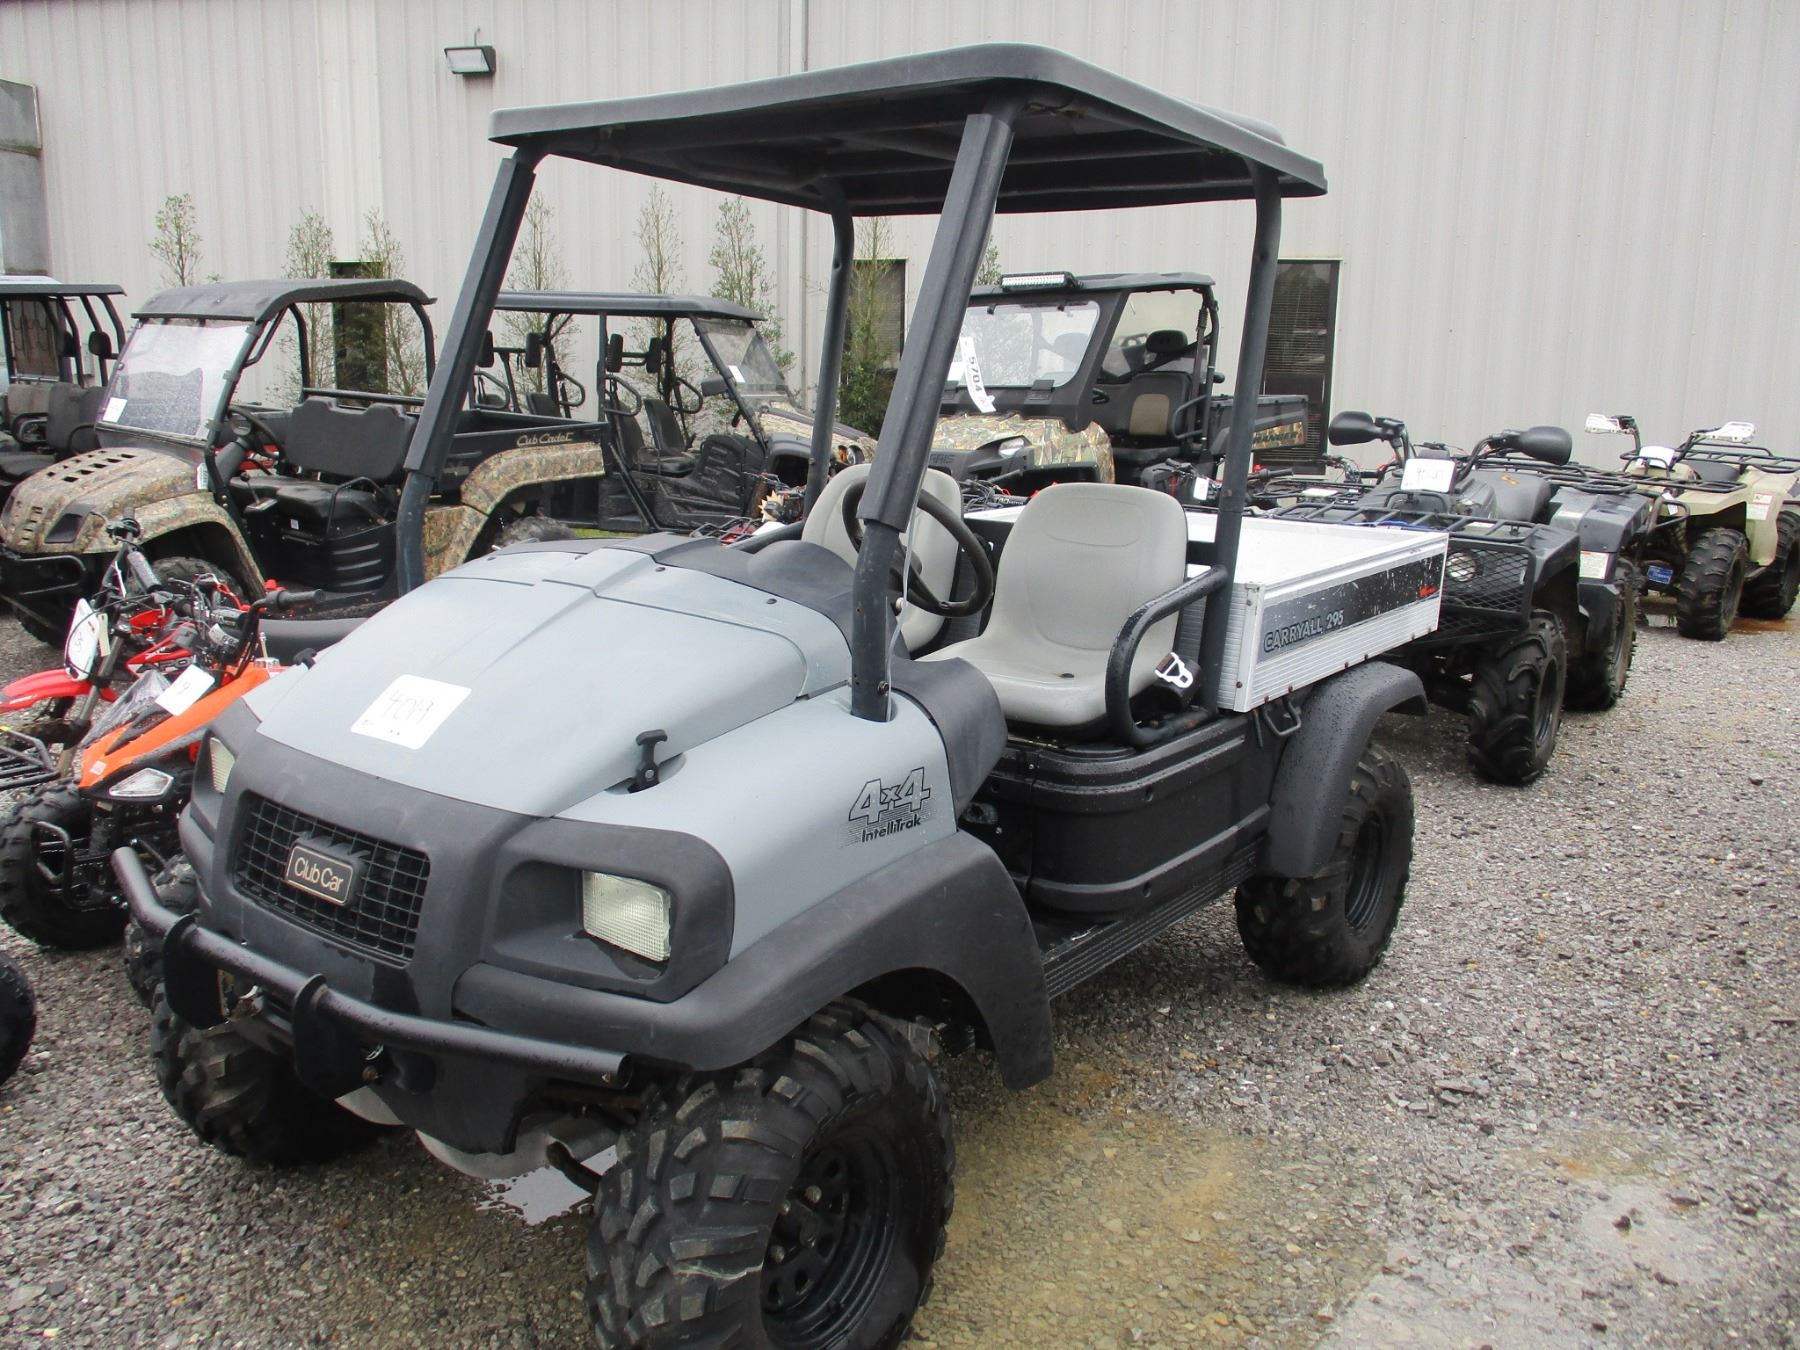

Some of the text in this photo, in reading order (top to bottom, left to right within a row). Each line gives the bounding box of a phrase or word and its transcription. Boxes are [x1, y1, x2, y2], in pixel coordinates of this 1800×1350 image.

[516, 432, 575, 448] Cub Cadet
[1263, 608, 1345, 653] CARRYALL 295
[848, 767, 931, 826] 4x4
[861, 814, 922, 843] IntelliTrak
[294, 856, 345, 893] Club Car
